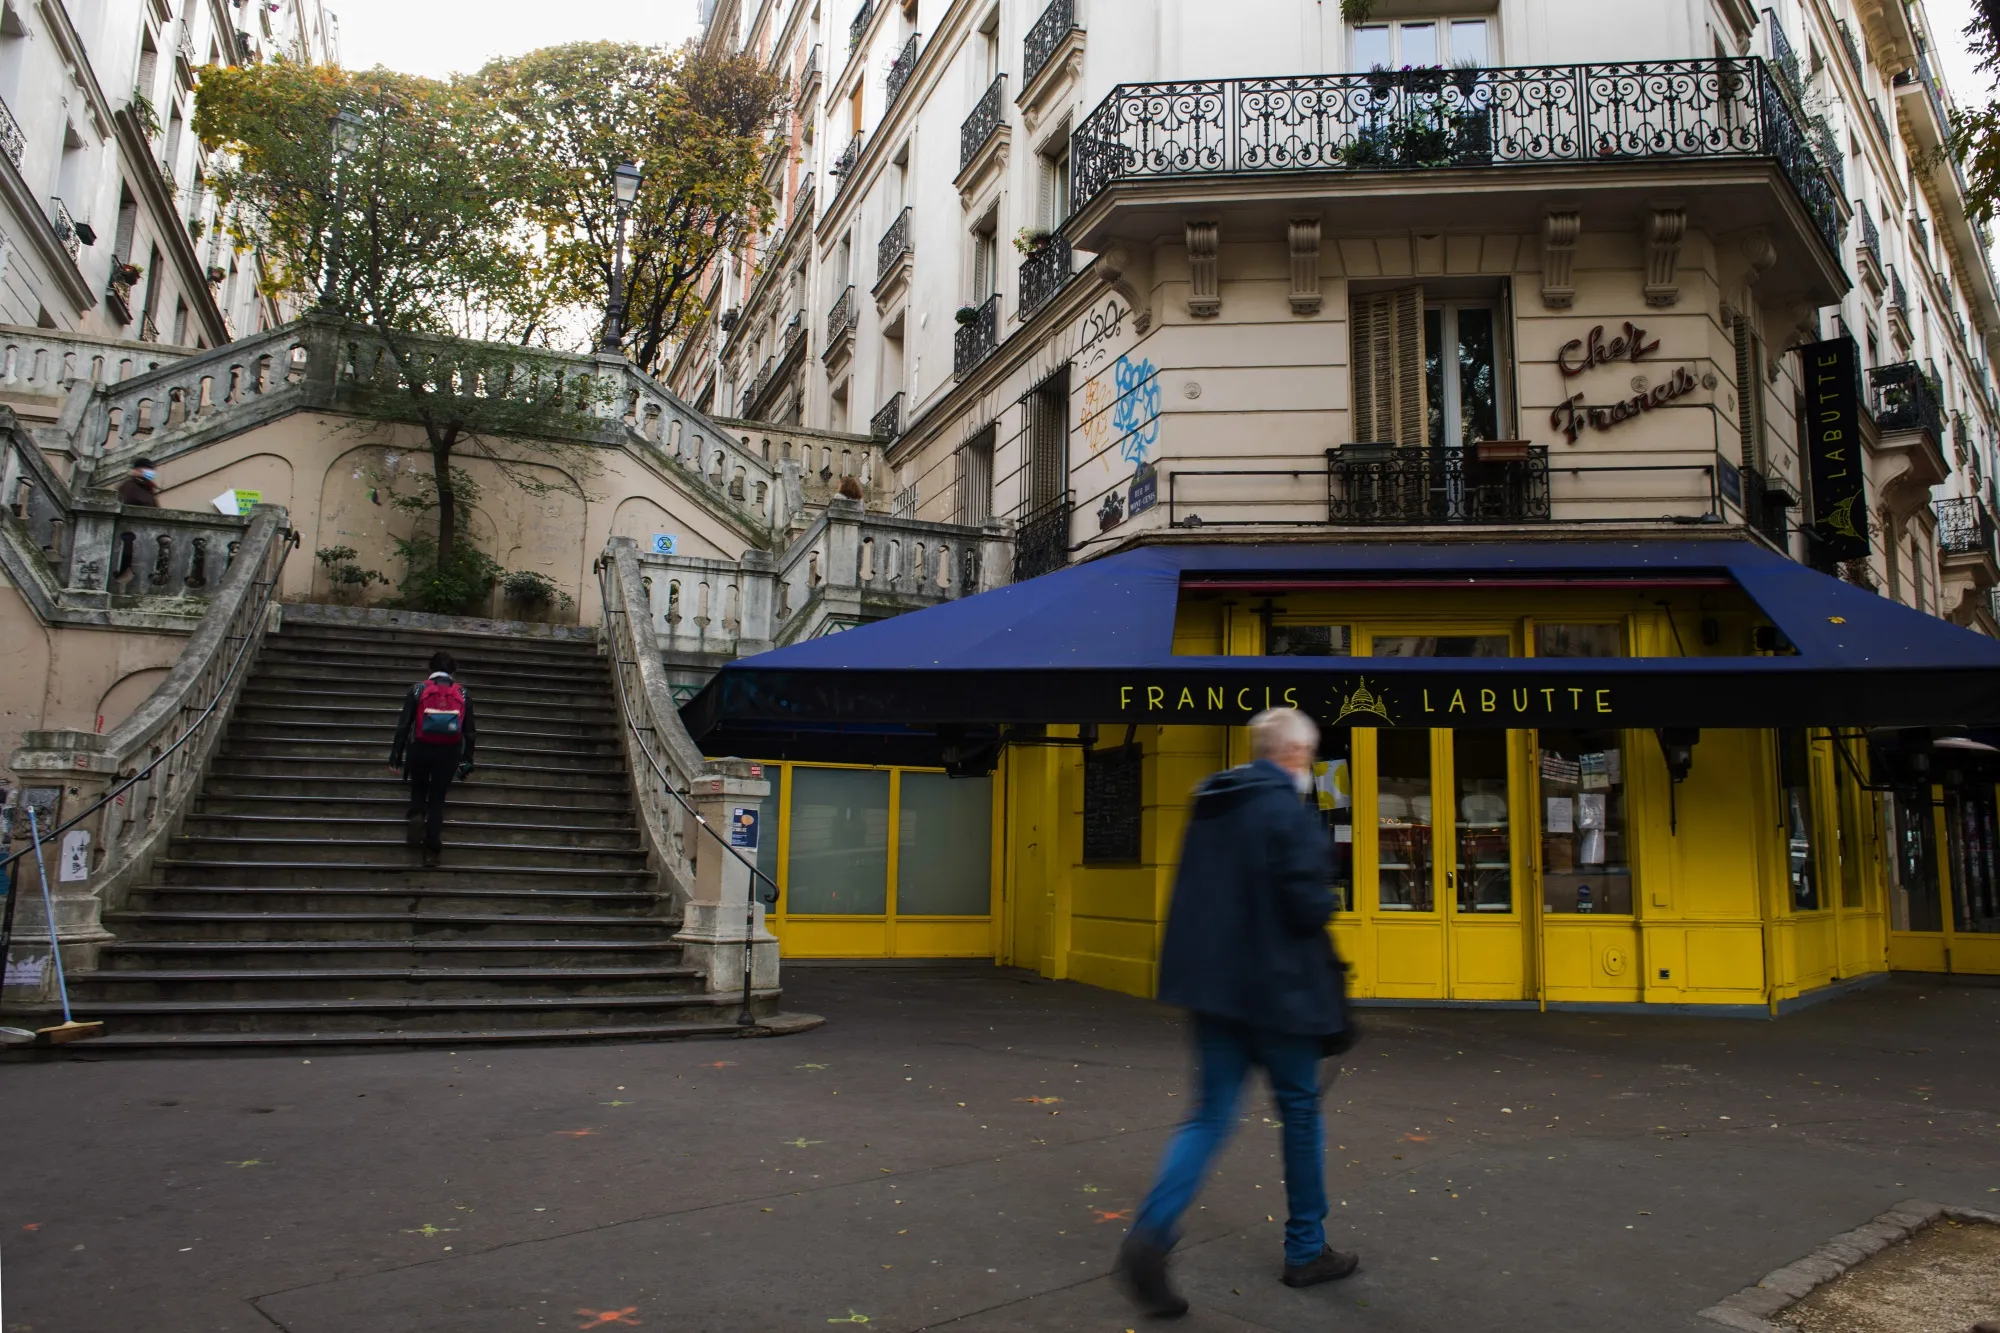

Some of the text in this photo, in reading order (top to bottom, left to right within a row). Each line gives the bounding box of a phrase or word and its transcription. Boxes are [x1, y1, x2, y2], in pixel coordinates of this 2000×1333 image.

[1558, 321, 1661, 378] Chez
[1550, 366, 1698, 446] Francis
[1817, 352, 1847, 479] LABUTTE
[1120, 686, 1613, 714] FRANCIS LABUTTE
